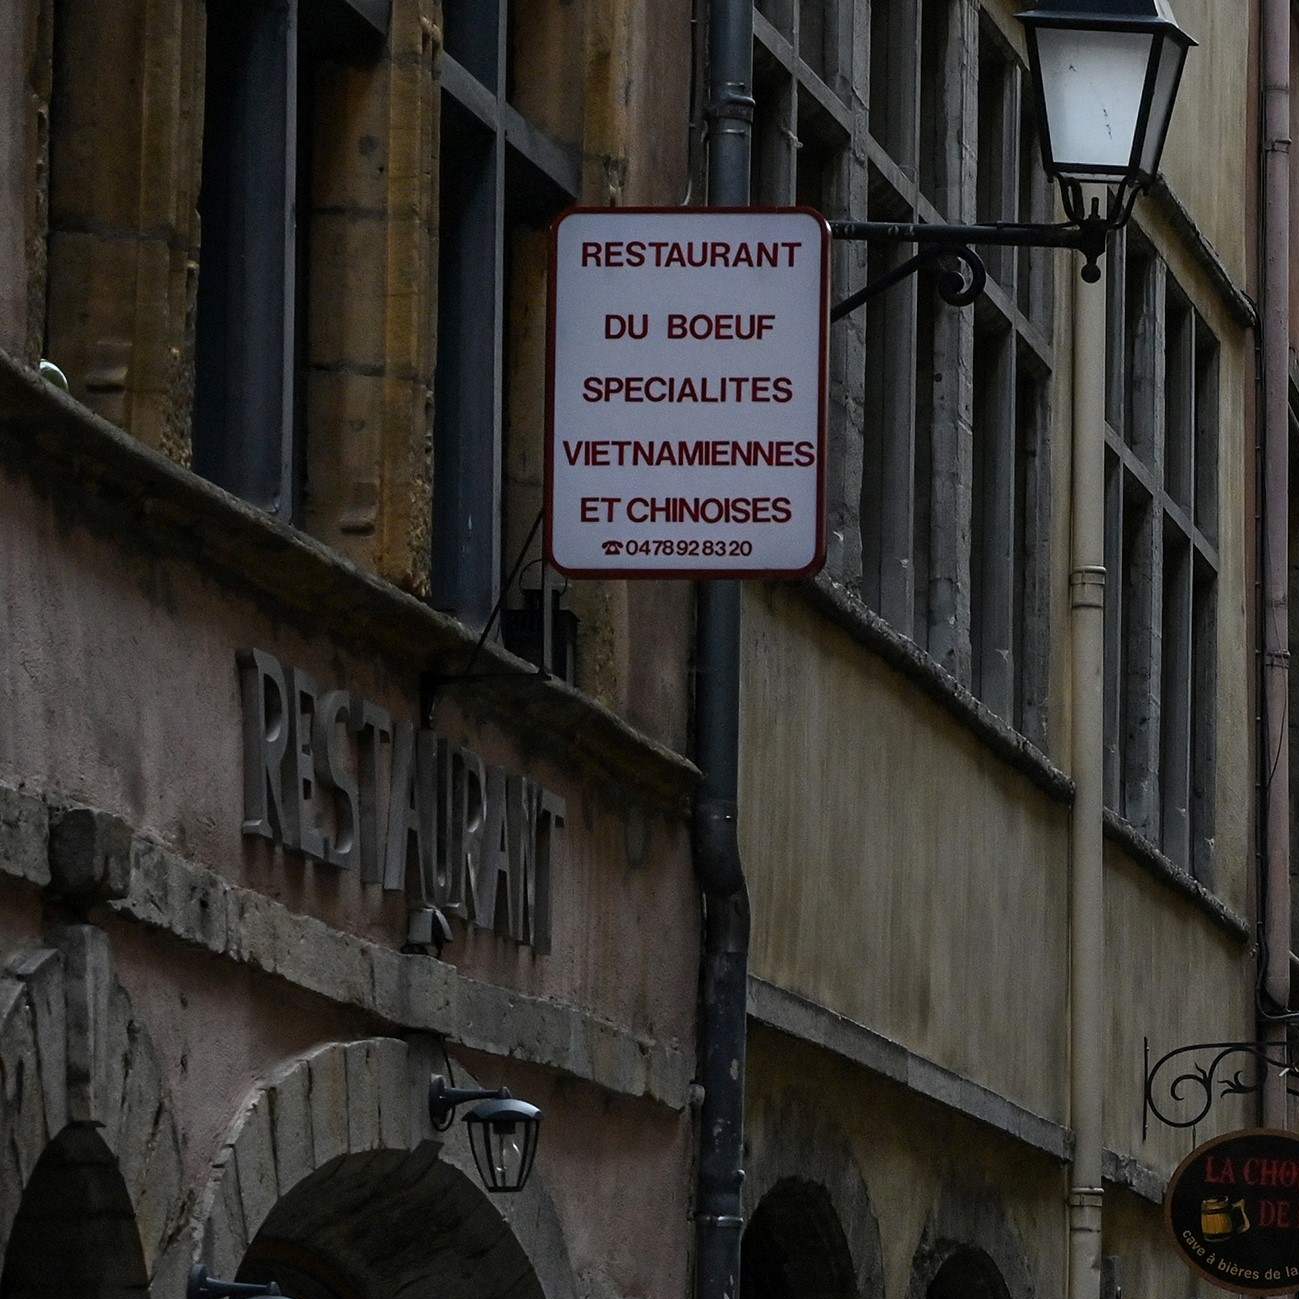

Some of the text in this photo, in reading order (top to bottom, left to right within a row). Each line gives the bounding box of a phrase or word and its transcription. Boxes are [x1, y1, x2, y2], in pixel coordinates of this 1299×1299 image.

[581, 241, 802, 268] RESTAURANT
[604, 314, 776, 340] DU BOEUF
[582, 377, 793, 403] SPECIALITES
[562, 441, 816, 467] VIETNAMIENNES
[580, 497, 792, 523] ET CHINOISES
[240, 647, 566, 954] RESTAURANT
[1204, 1156, 1236, 1185] LA
[1256, 1200, 1290, 1229] DE
[1182, 1229, 1207, 1259] cave
[1206, 1252, 1217, 1265] à
[1218, 1258, 1260, 1280] bières
[1264, 1267, 1281, 1280] de
[1285, 1266, 1299, 1278] la
